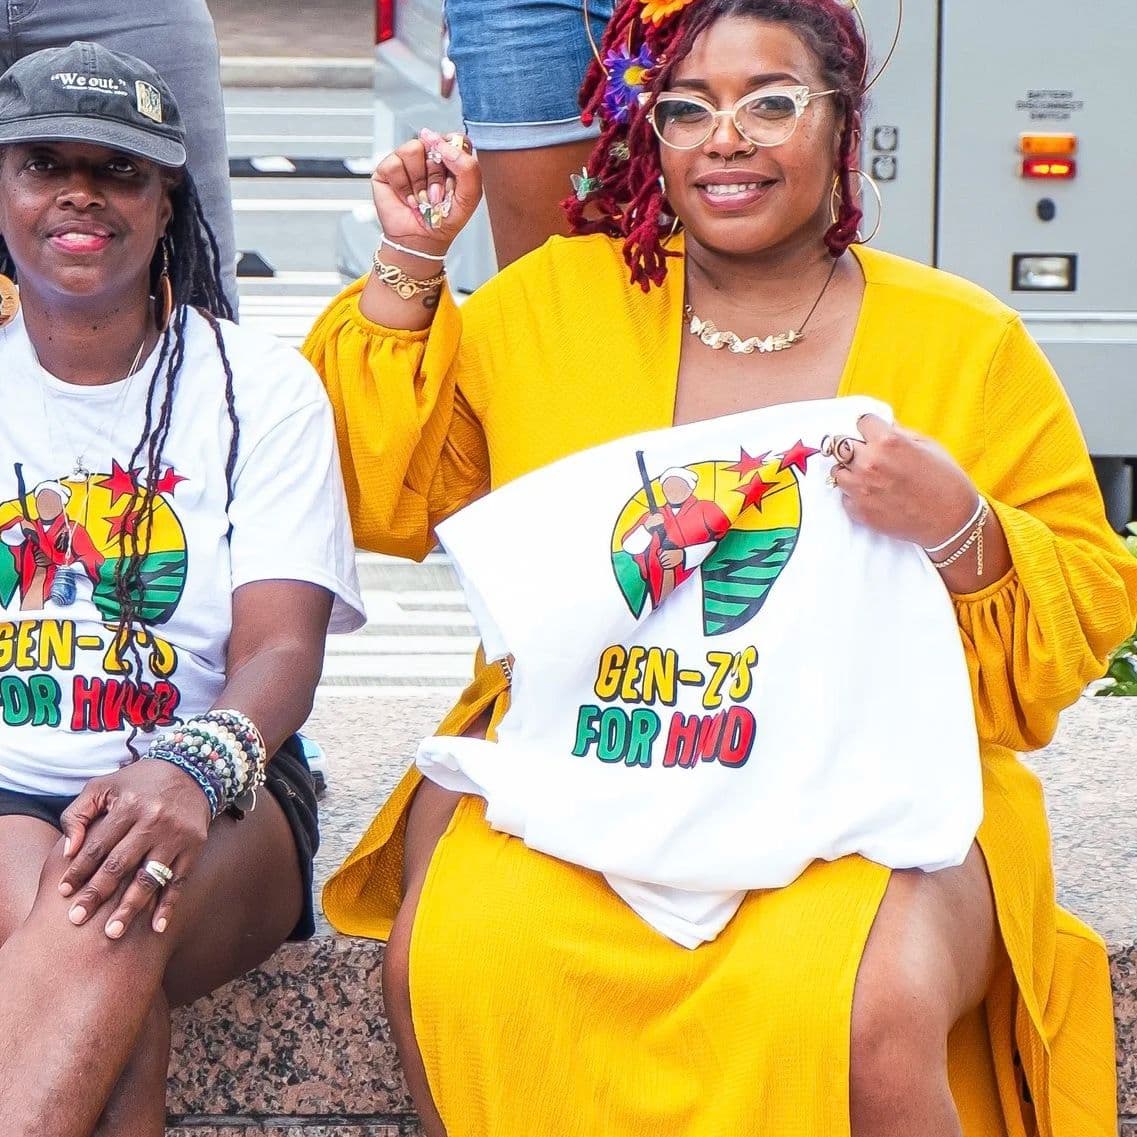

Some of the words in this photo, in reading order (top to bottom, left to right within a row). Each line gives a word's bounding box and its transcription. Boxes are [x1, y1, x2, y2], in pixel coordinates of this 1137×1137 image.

[594, 644, 759, 710] GEN-Z'S
[571, 704, 661, 768] FOR
[662, 705, 757, 769] HWD
